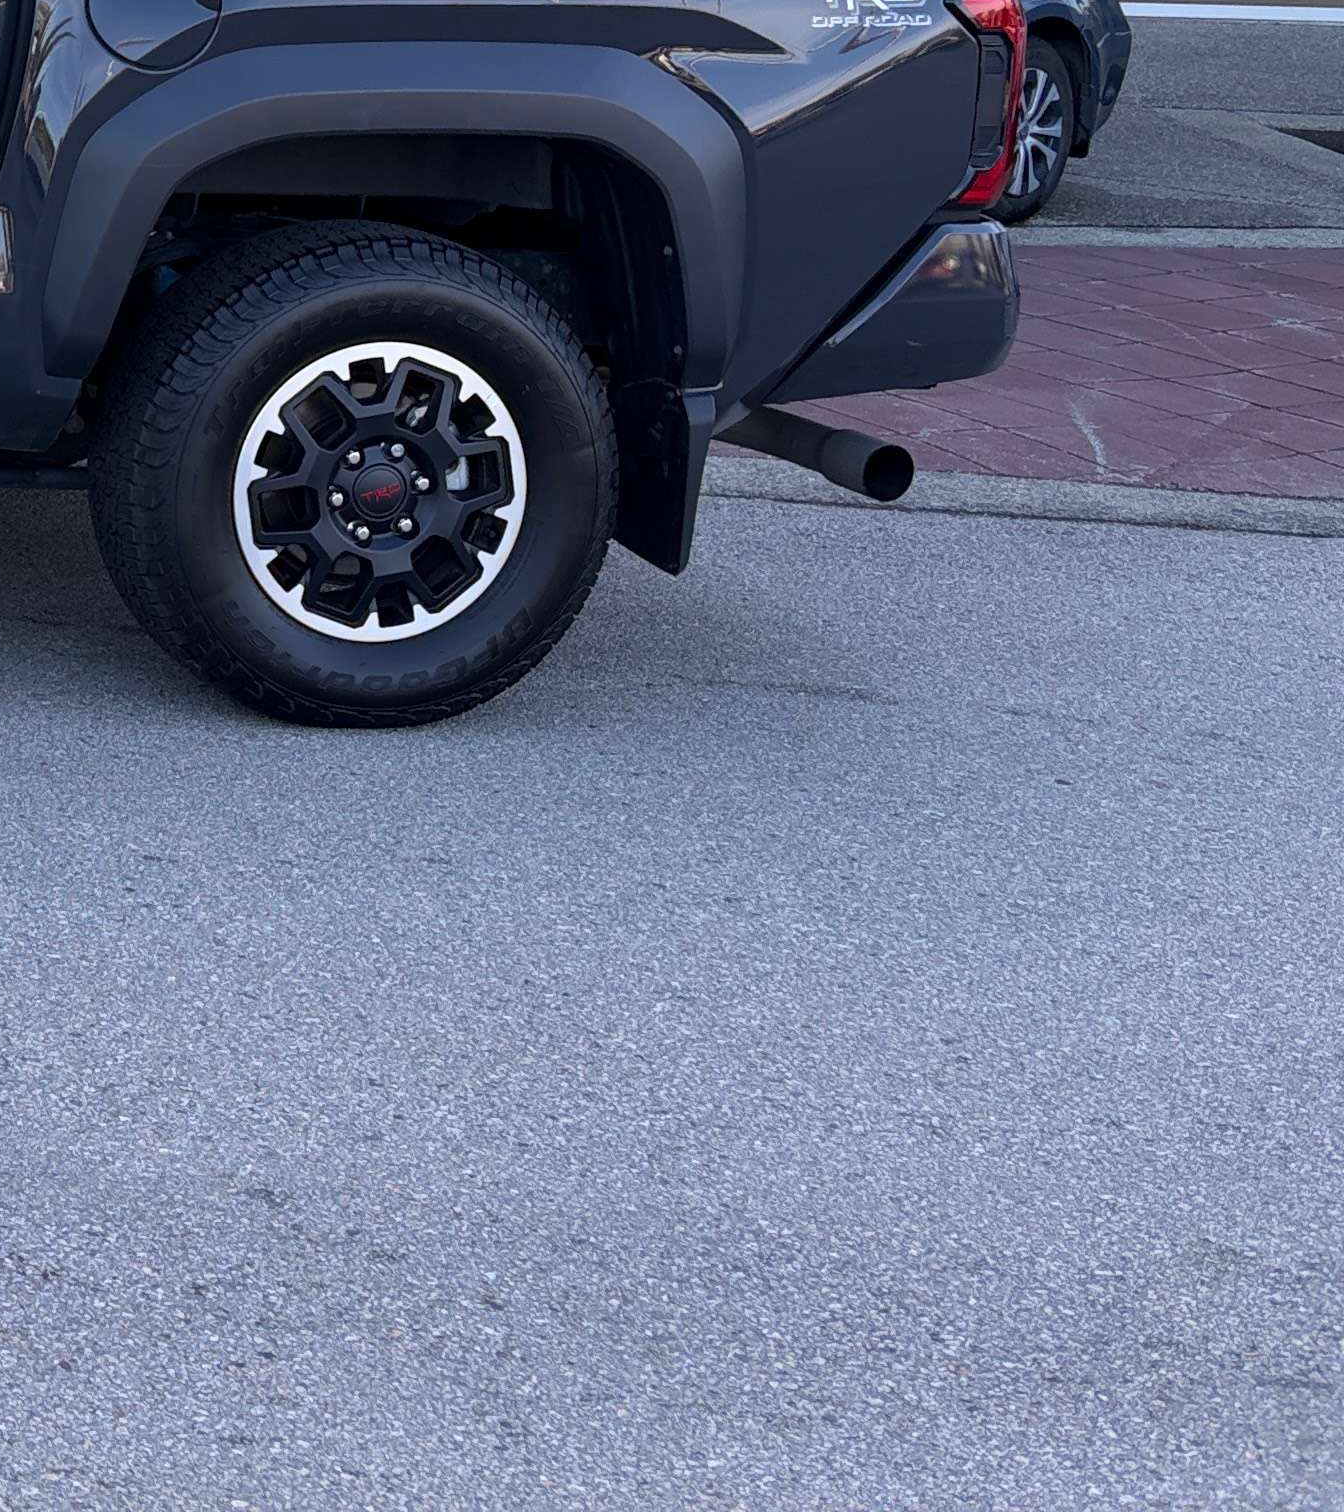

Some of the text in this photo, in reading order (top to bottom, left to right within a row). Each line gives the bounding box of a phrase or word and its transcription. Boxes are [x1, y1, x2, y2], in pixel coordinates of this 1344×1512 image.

[811, 14, 932, 28] OFF ROAD
[360, 482, 401, 503] TRD
